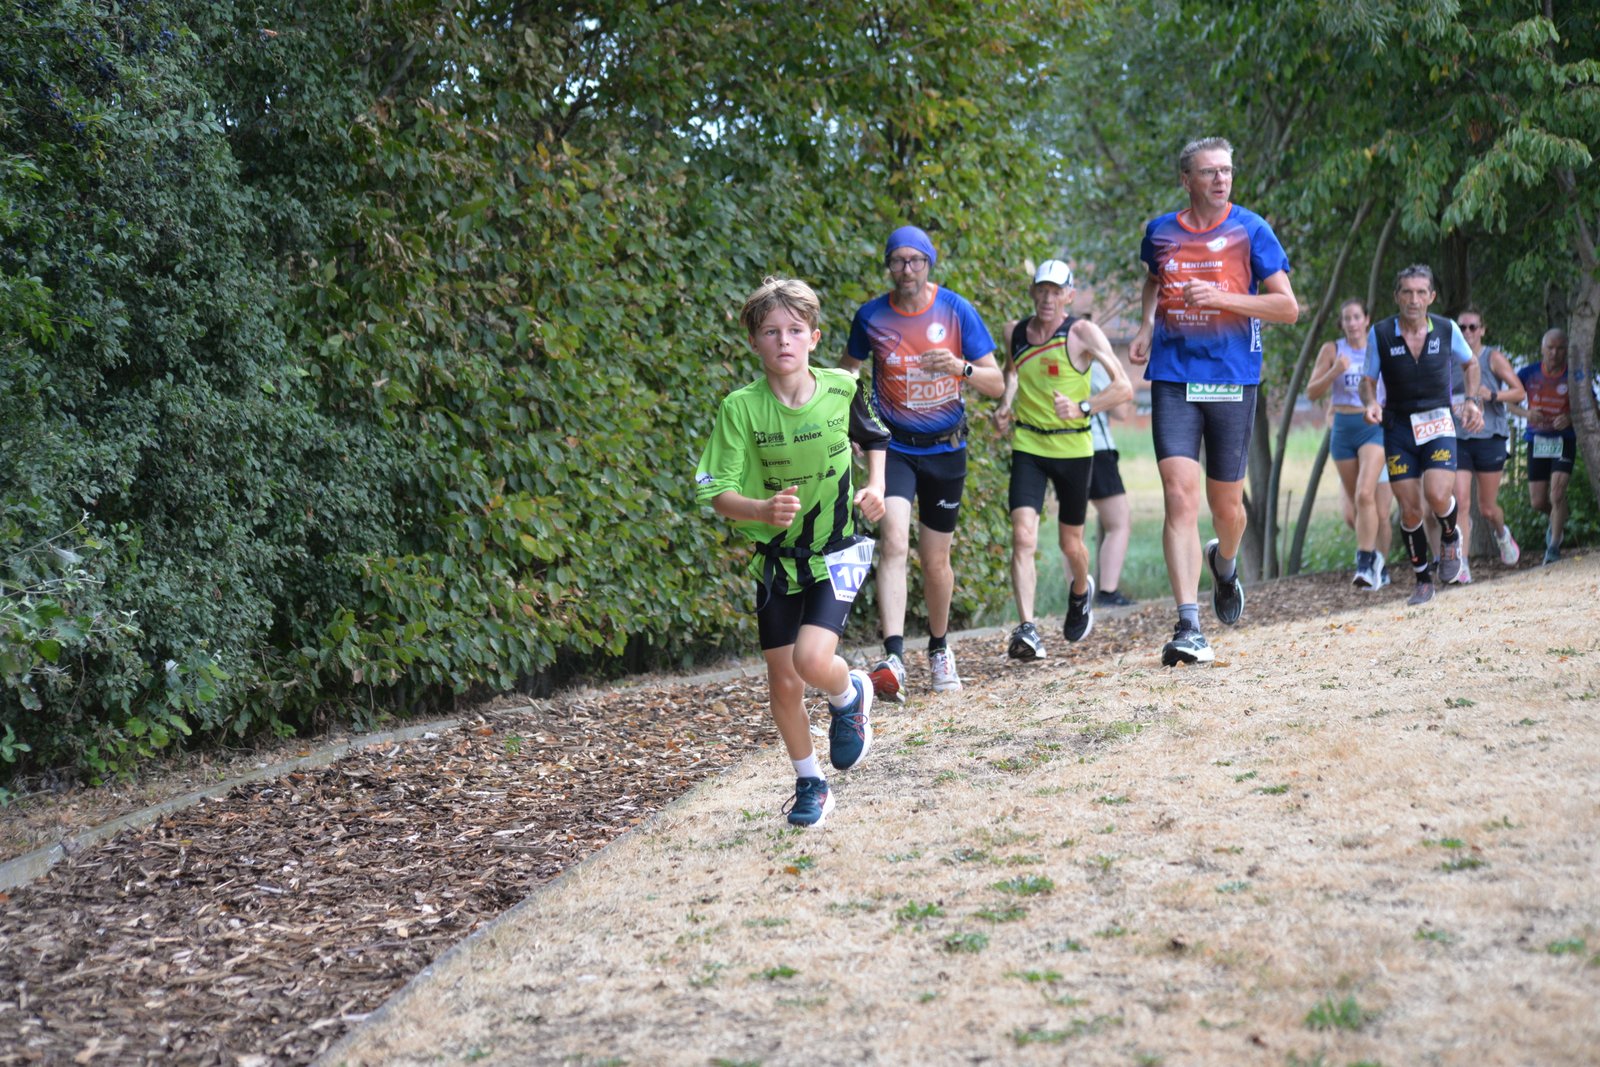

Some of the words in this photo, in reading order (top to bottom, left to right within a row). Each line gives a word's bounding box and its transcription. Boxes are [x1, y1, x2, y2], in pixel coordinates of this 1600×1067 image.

[910, 378, 955, 399] 2002
[793, 431, 823, 443] Athlex
[1416, 419, 1454, 438] 2032
